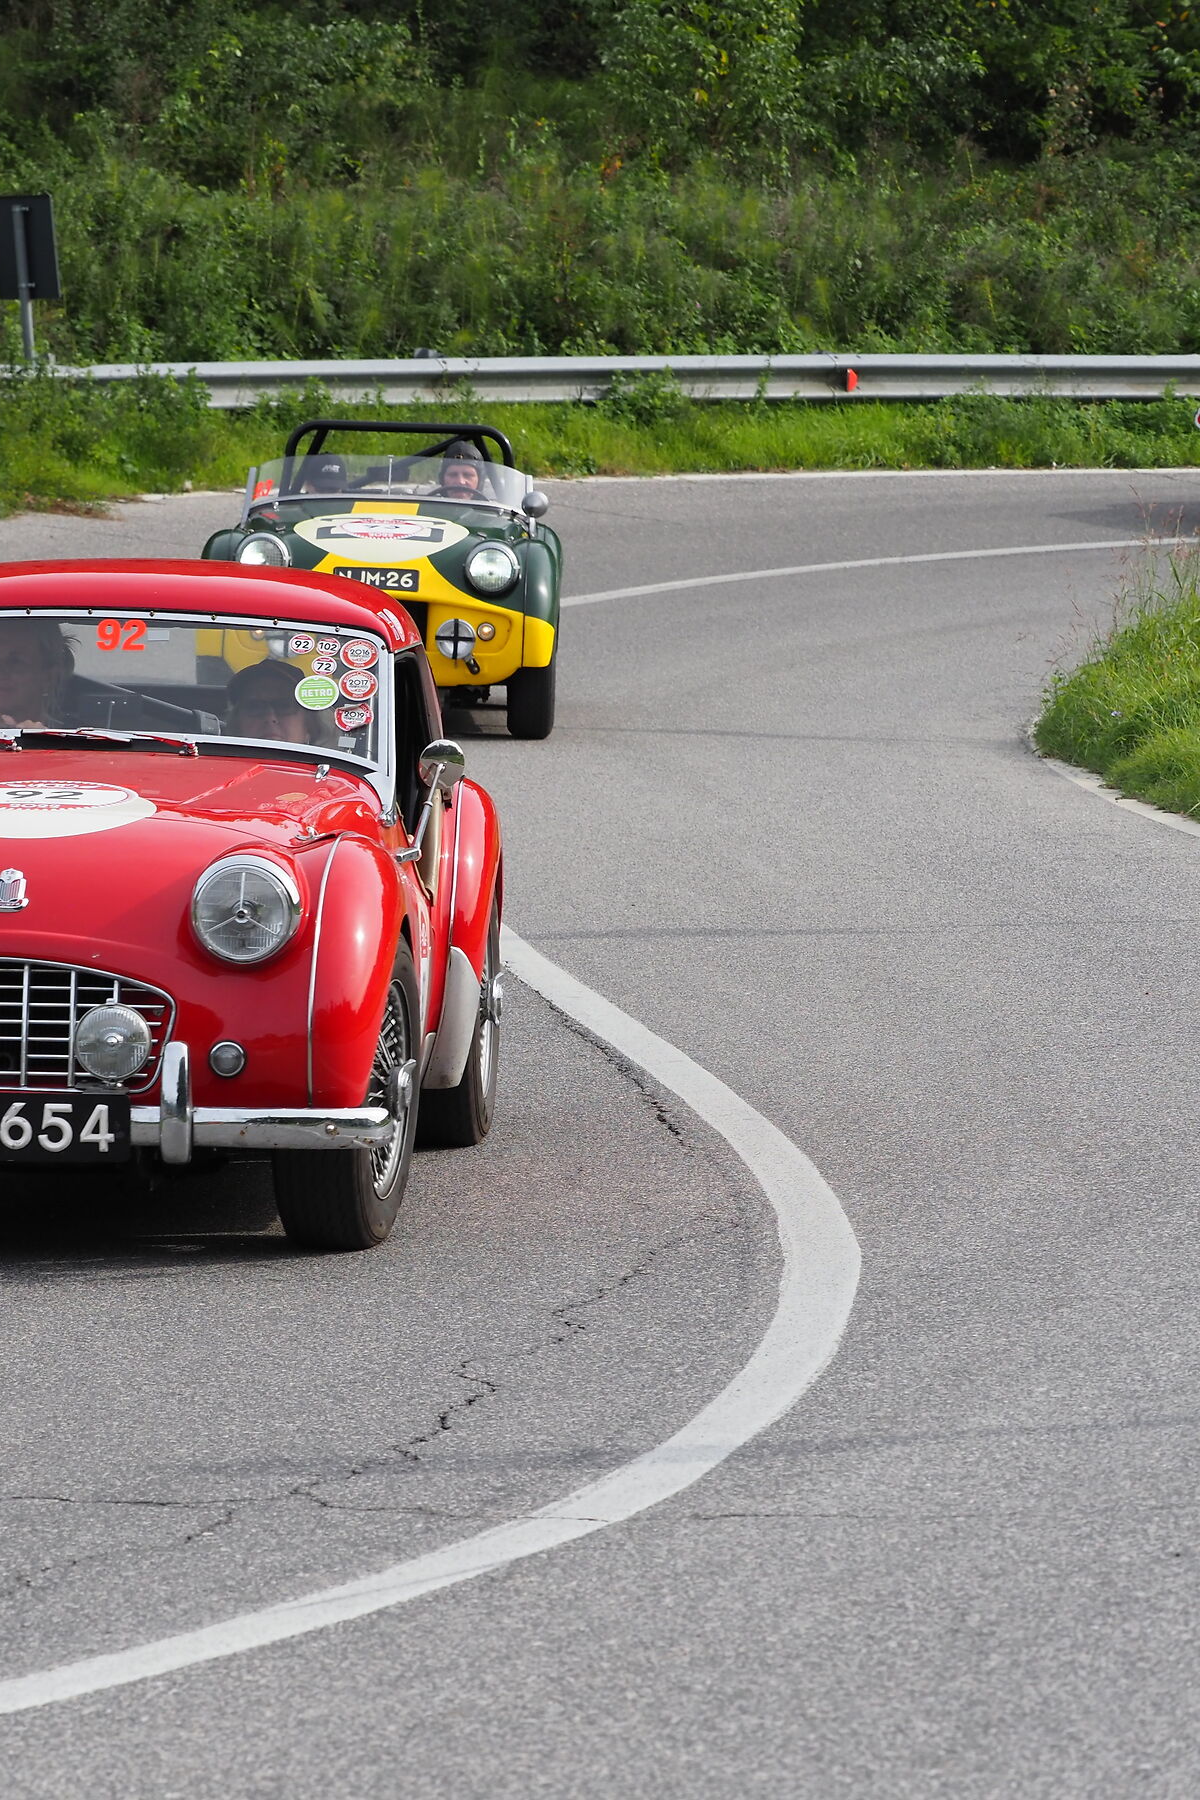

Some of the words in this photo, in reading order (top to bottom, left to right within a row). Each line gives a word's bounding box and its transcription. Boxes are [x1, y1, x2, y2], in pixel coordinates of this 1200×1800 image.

[96, 618, 146, 651] 92
[294, 640, 310, 650] 92
[319, 642, 338, 652] 102
[350, 648, 370, 656] 2016
[317, 662, 332, 672] 72
[301, 688, 333, 698] RETRO
[344, 711, 365, 719] 2019
[6, 789, 84, 800] 92
[0, 1101, 116, 1153] 654
